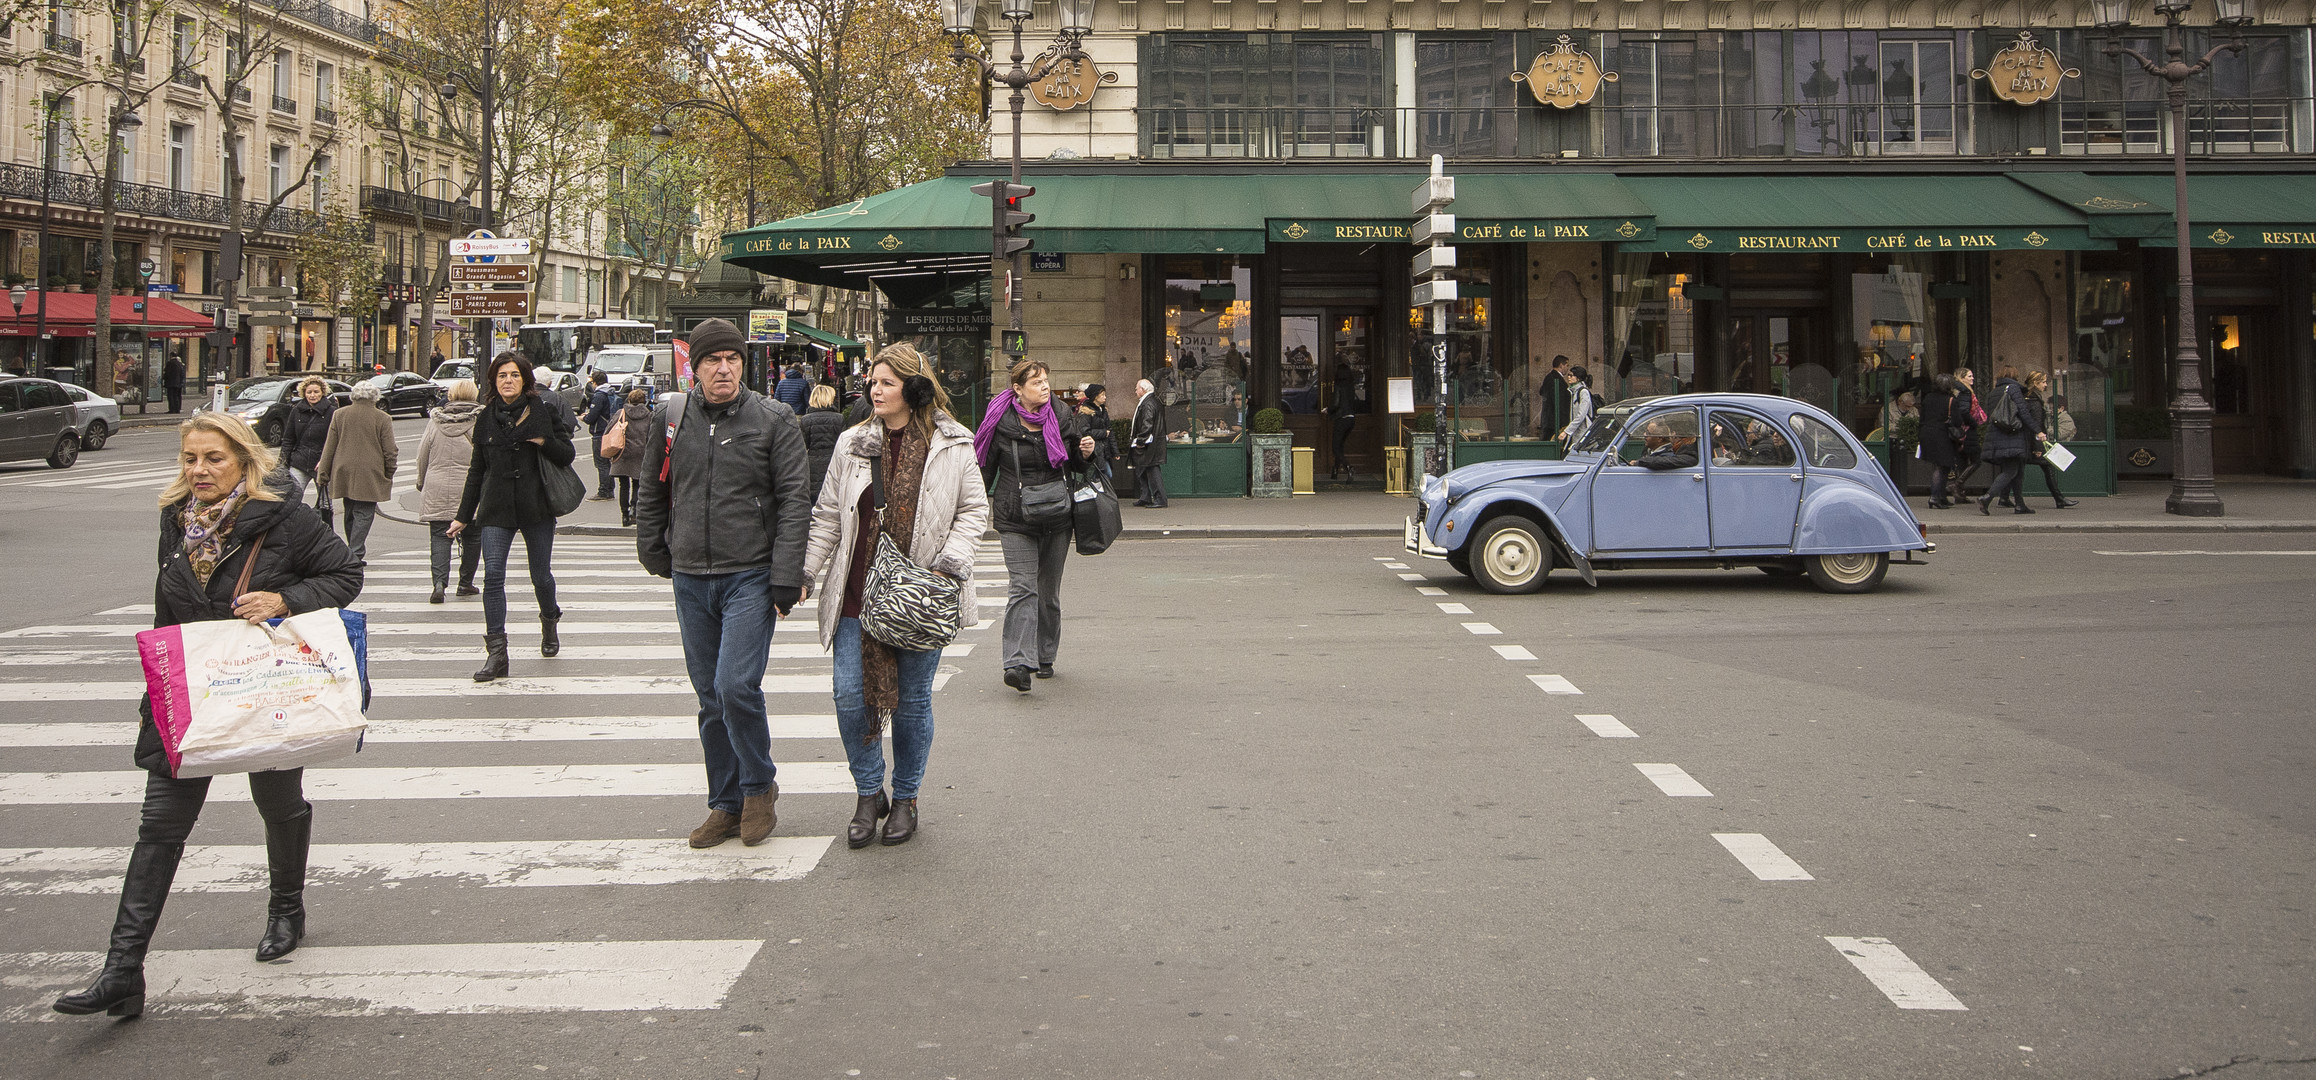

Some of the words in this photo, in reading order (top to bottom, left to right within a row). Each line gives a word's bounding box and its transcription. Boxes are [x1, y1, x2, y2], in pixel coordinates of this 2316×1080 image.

[1044, 84, 1082, 98] PAIX
[1335, 226, 1413, 238] RESTAURA
[1463, 224, 1502, 239] CAFÉ
[1510, 225, 1526, 238] de
[1534, 225, 1546, 238] la
[1554, 225, 1590, 238] PAIX
[2262, 232, 2316, 244] RESTAU
[745, 236, 773, 253] CAFÉ
[778, 238, 792, 251] de
[799, 237, 810, 250] la
[817, 236, 851, 249] PAIX
[1738, 236, 1841, 249] RESTAURANT
[1866, 233, 1907, 248] CAFÉ
[1914, 235, 1932, 248] de
[1939, 235, 1952, 247] la
[1960, 234, 1997, 247] PAIX
[1035, 261, 1061, 269] L'OPÉRA
[905, 316, 922, 324] LES
[923, 315, 956, 324] FRUITS
[956, 315, 970, 323] DE
[971, 315, 992, 323] MER
[917, 325, 928, 333] du
[929, 324, 945, 333] Café
[255, 694, 301, 709] BASKETS
[275, 712, 283, 720] U
